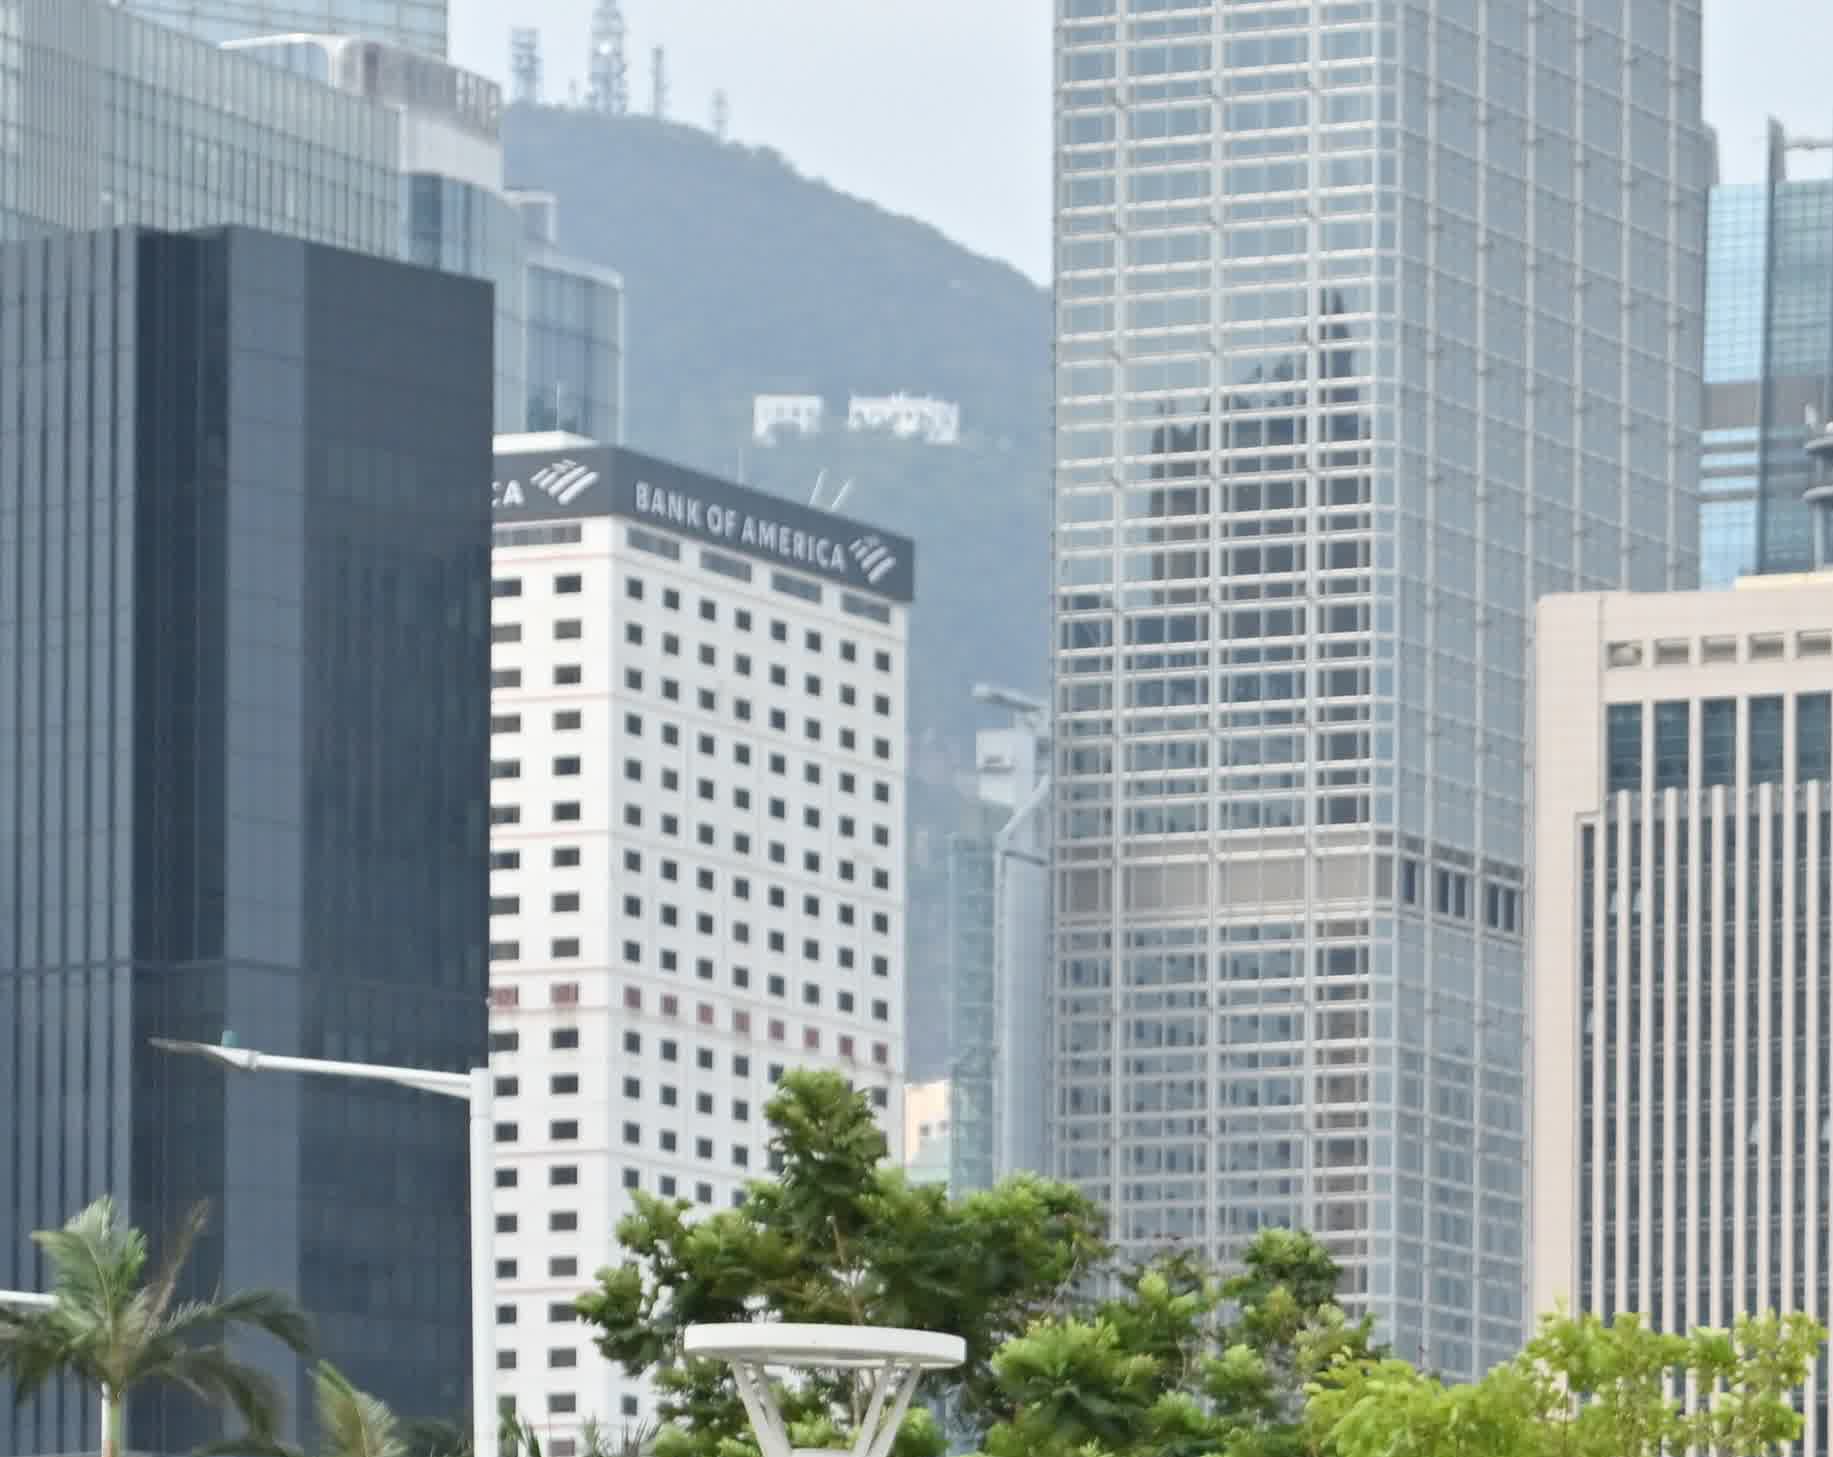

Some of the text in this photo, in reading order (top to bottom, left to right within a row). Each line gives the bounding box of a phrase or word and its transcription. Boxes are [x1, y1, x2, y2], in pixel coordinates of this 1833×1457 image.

[634, 480, 846, 574] BANK OF AMERICA
